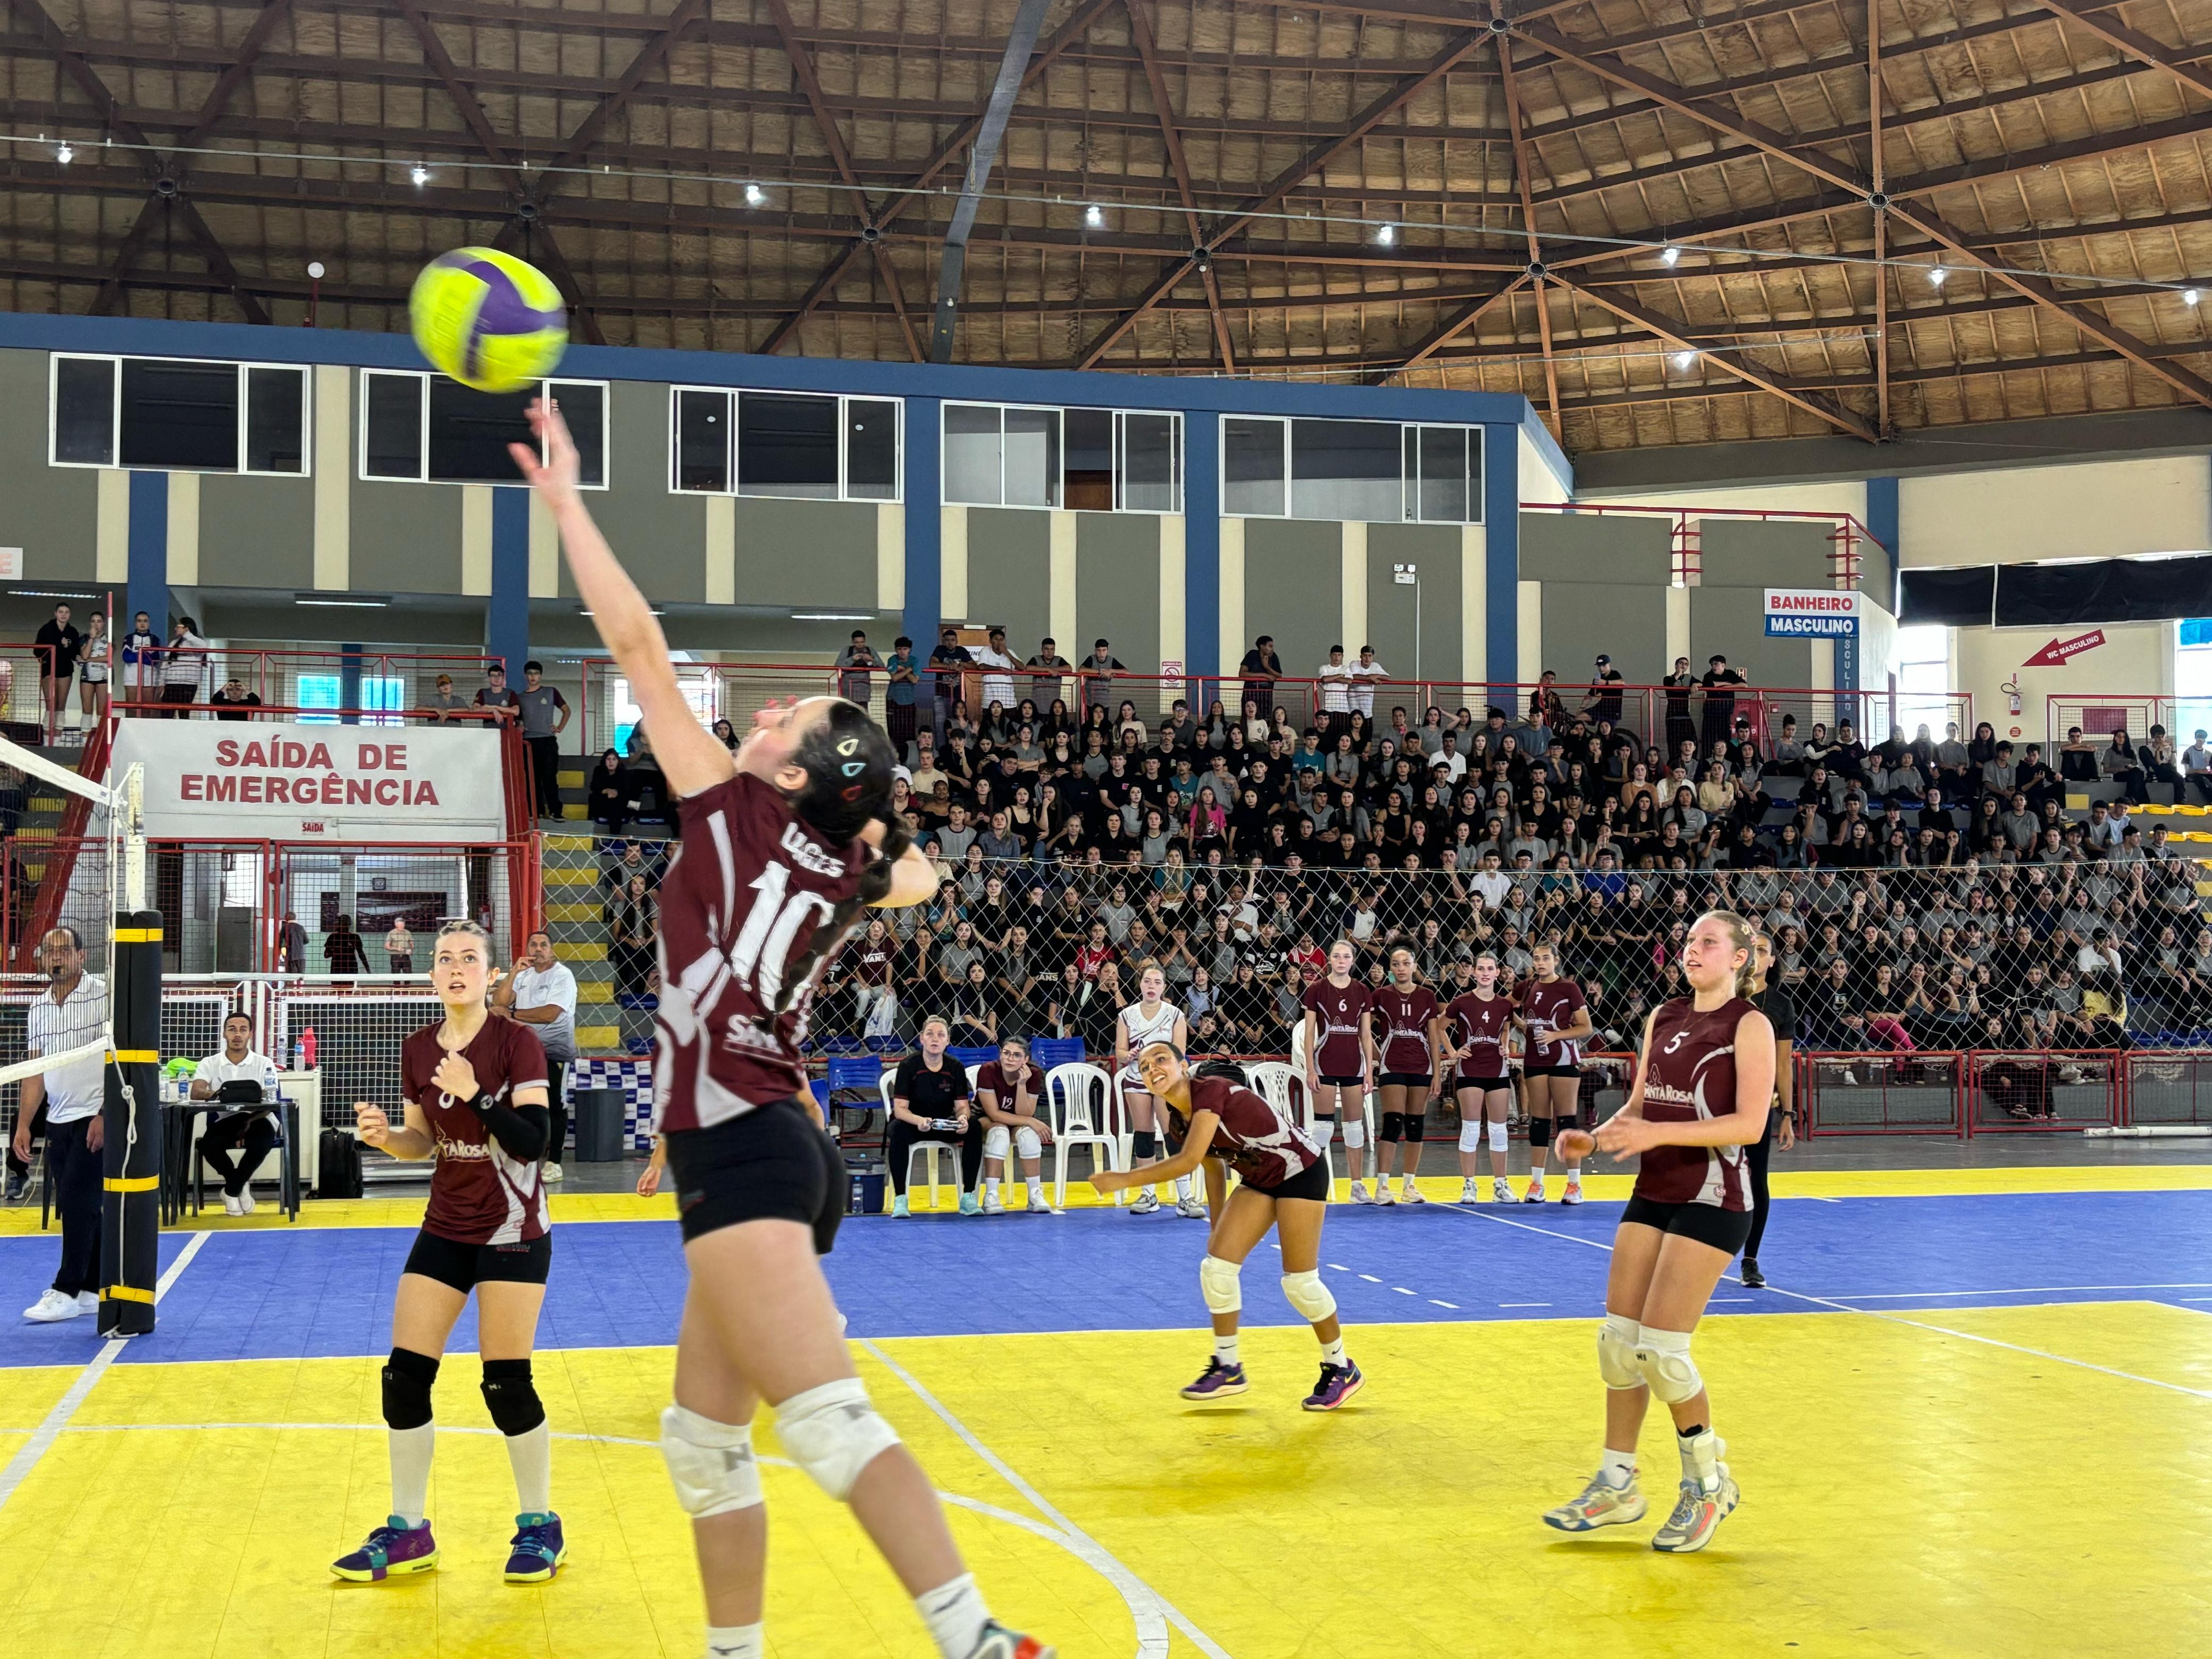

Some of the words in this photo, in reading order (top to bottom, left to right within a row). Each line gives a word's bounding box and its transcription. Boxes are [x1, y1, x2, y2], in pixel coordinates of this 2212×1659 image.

[1771, 596, 1853, 610] BANHEIRO
[1771, 617, 1854, 633] MASCULINO
[2047, 650, 2059, 659] WC
[2059, 635, 2099, 655] MASCULINO
[216, 735, 334, 769] SAÍDA
[358, 744, 407, 770] DE
[181, 772, 440, 806] EMERGÊNCIA
[302, 823, 324, 832] SAÍDA
[1535, 992, 1543, 1004] 7
[1339, 999, 1347, 1012] 6
[1402, 1003, 1411, 1016] 11
[1481, 1011, 1490, 1023] 4
[1664, 1032, 1691, 1054] 5
[1001, 1096, 1013, 1109] 12
